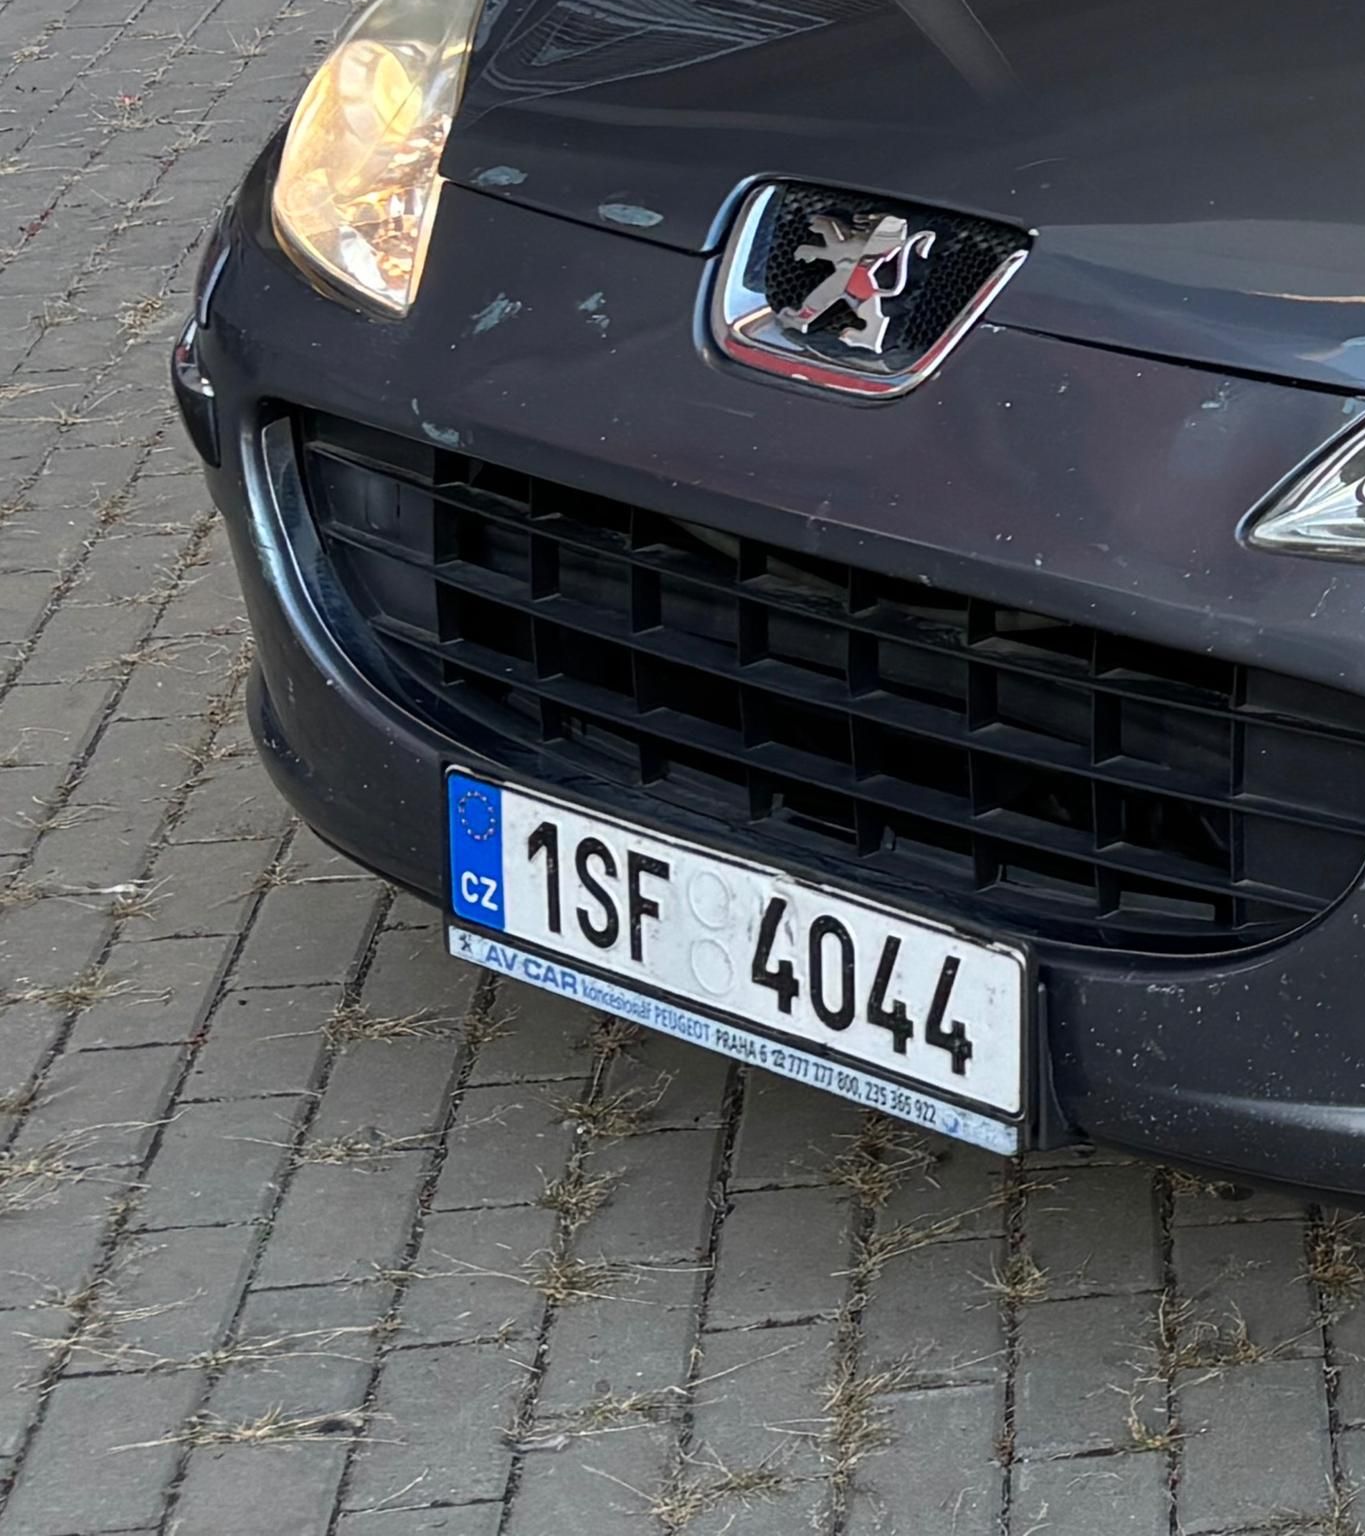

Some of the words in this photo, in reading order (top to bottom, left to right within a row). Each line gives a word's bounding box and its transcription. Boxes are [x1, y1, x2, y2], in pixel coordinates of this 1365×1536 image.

[461, 870, 499, 912] CZ
[528, 820, 671, 963] 1SF
[751, 896, 973, 1076] 4044
[485, 944, 519, 971] AV
[523, 959, 579, 995] CAR
[654, 1004, 711, 1042] PEUGEOT
[715, 1028, 757, 1062] PRAHA
[759, 1044, 768, 1064] 6
[787, 1053, 810, 1078] 777
[812, 1061, 834, 1087] 777
[865, 1080, 887, 1106] 235
[914, 1099, 937, 1125] 922
